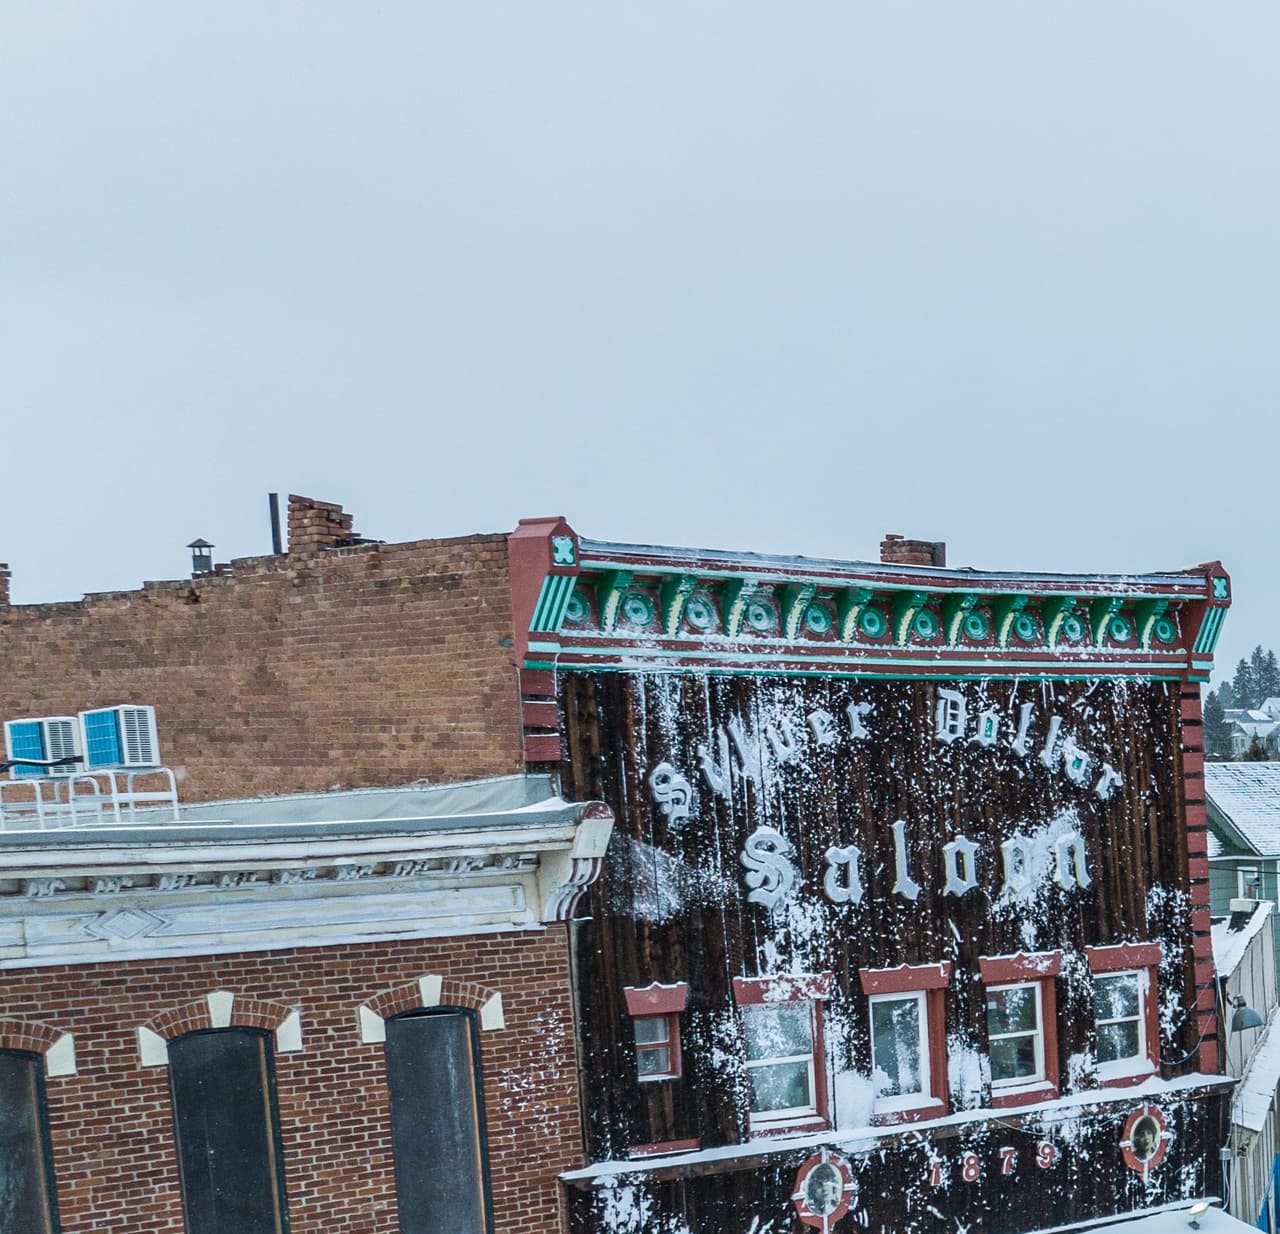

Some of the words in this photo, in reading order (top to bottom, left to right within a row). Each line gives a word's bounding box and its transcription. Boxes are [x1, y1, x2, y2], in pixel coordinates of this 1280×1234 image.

[935, 686, 1124, 801] Dollar
[739, 819, 1093, 905] Saloon
[928, 1140, 1057, 1187] 1879
